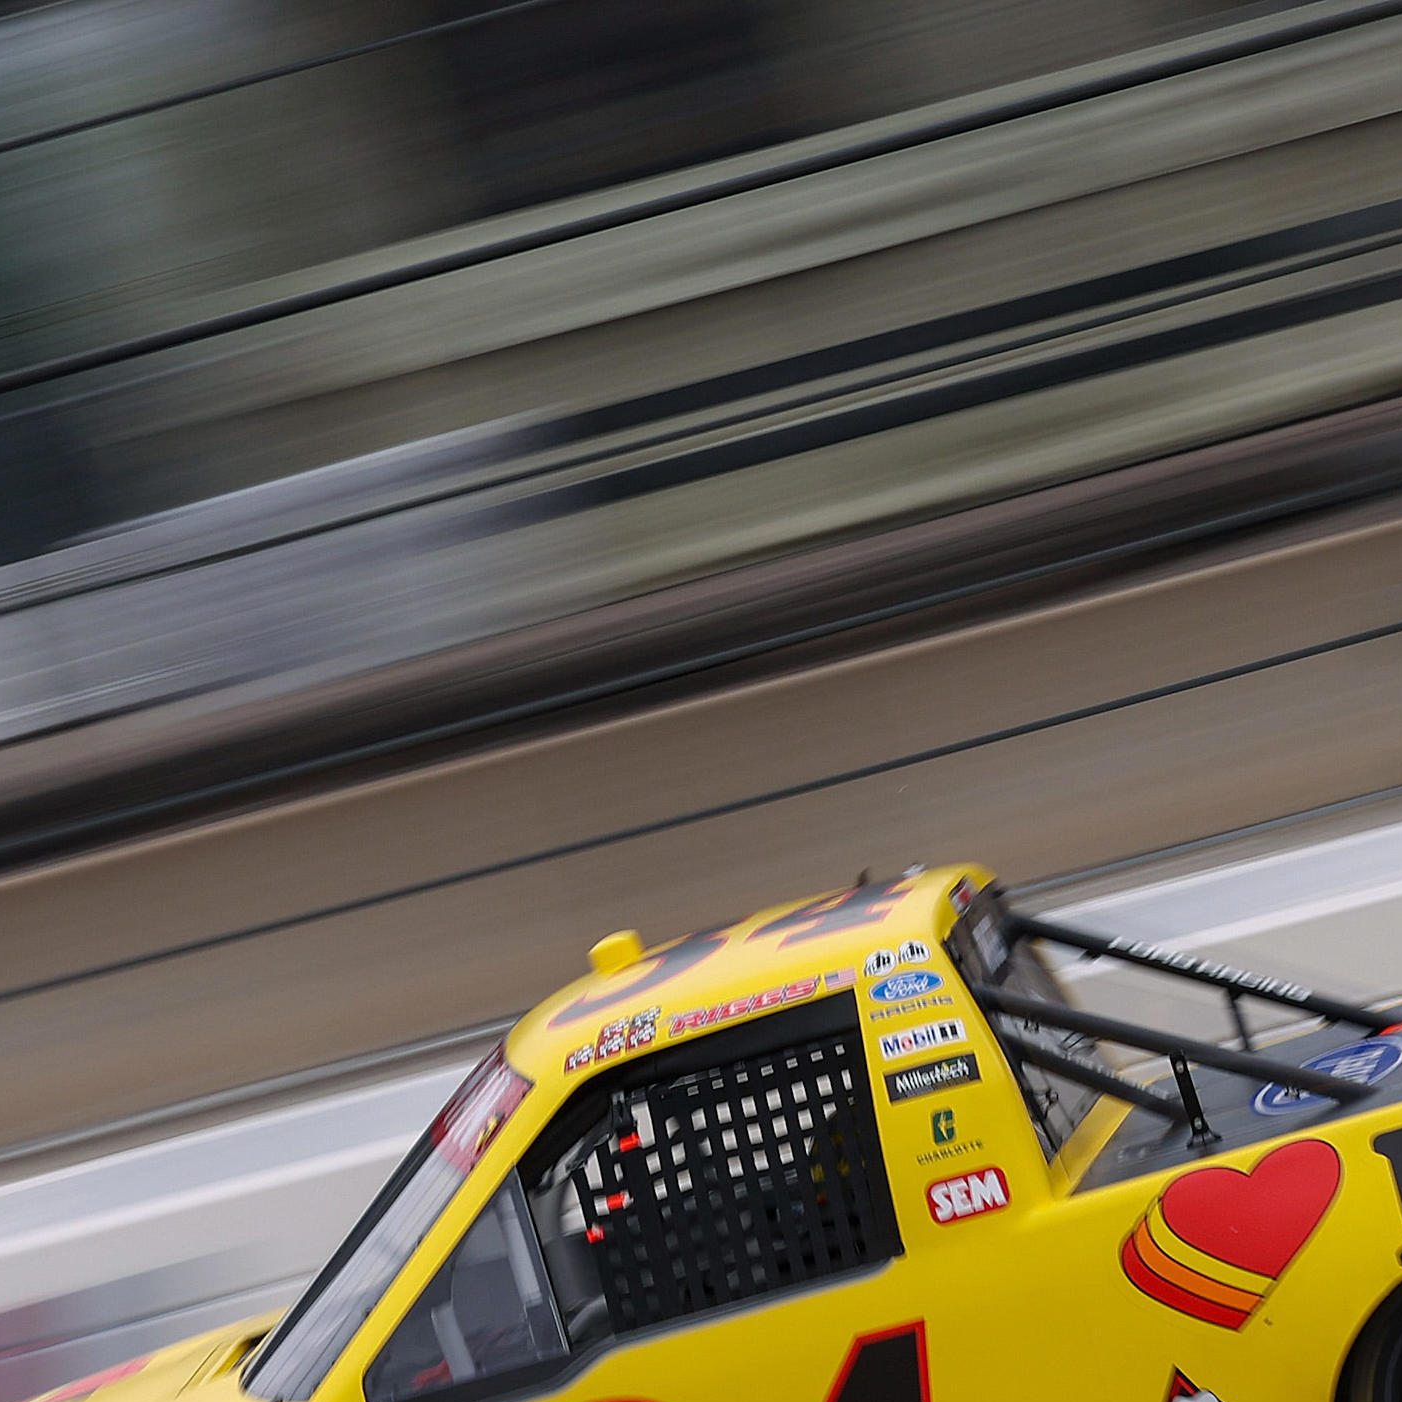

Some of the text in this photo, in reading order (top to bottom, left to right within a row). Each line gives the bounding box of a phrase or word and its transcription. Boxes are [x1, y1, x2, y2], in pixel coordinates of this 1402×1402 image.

[883, 974, 931, 1000] Ford
[882, 1027, 936, 1057] Mobil
[930, 1169, 1008, 1222] SEM
